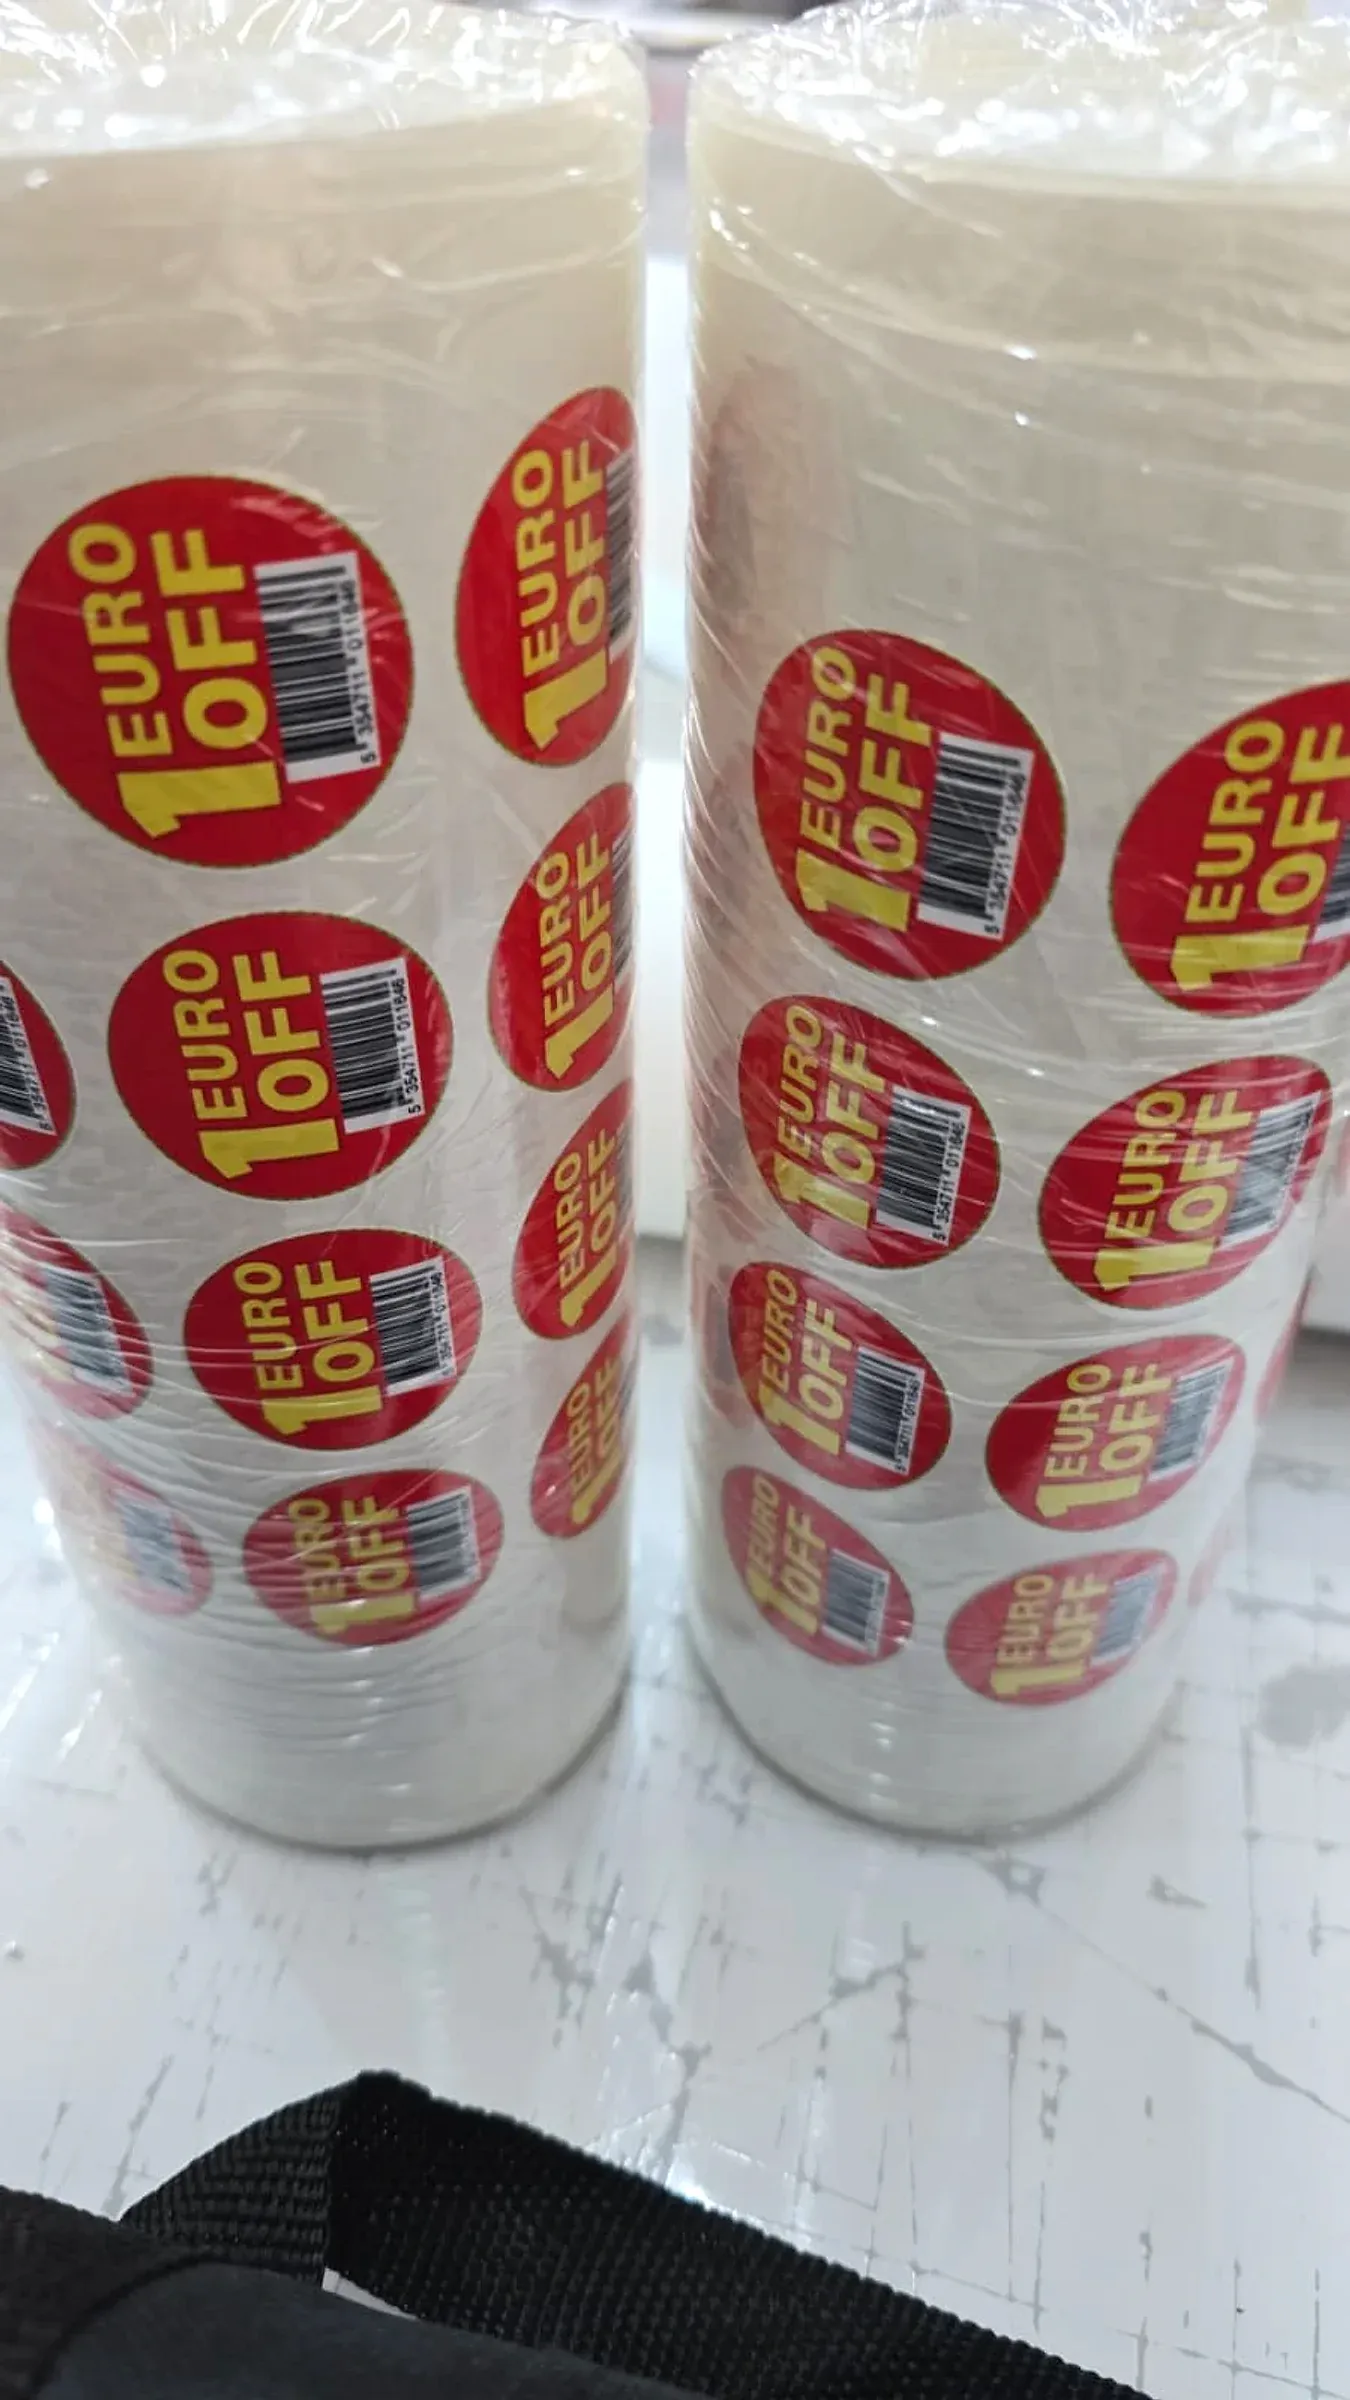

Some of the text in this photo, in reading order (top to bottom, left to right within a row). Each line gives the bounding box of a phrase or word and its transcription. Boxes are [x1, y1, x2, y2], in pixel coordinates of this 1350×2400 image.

[512, 449, 607, 751] 1 EURO
[562, 440, 607, 646] OFF
[68, 522, 281, 839] 1 EURO
[150, 529, 268, 749] OFF
[352, 671, 373, 737] 354711
[796, 646, 911, 932] 1 EURO
[853, 674, 932, 873] OFF
[1185, 720, 1285, 923] EURO
[1257, 723, 1350, 916] OFF
[535, 852, 614, 1080] 1 EURO
[576, 833, 613, 991] OFF
[1170, 924, 1309, 991] 1
[162, 950, 339, 1179] 1 EURO
[232, 951, 329, 1112] OFF
[391, 978, 411, 1031] 011646
[401, 1045, 419, 1095] 354711
[774, 1004, 870, 1230] 1 EURO
[822, 1032, 885, 1184] OFF
[1167, 1090, 1253, 1232] OFF
[554, 1151, 617, 1327] 1 EURO
[588, 1128, 617, 1253] OFF
[1094, 1090, 1216, 1291] 1 EURO
[233, 1261, 383, 1435] 1 EURO
[295, 1260, 375, 1382] OFF
[758, 1269, 840, 1456] 1 EURO
[798, 1298, 853, 1420] OFF
[567, 1381, 624, 1525] 1 EURO
[595, 1356, 624, 1459] OFF
[1036, 1364, 1143, 1518] 1 EURO
[1099, 1363, 1173, 1471] OFF
[288, 1498, 415, 1634] 1 EURO
[342, 1496, 410, 1591] OFF
[746, 1475, 818, 1636] 1 EURO
[781, 1501, 826, 1606] OFF
[1047, 1573, 1107, 1661] OFF
[990, 1574, 1085, 1696] 1 EURO
